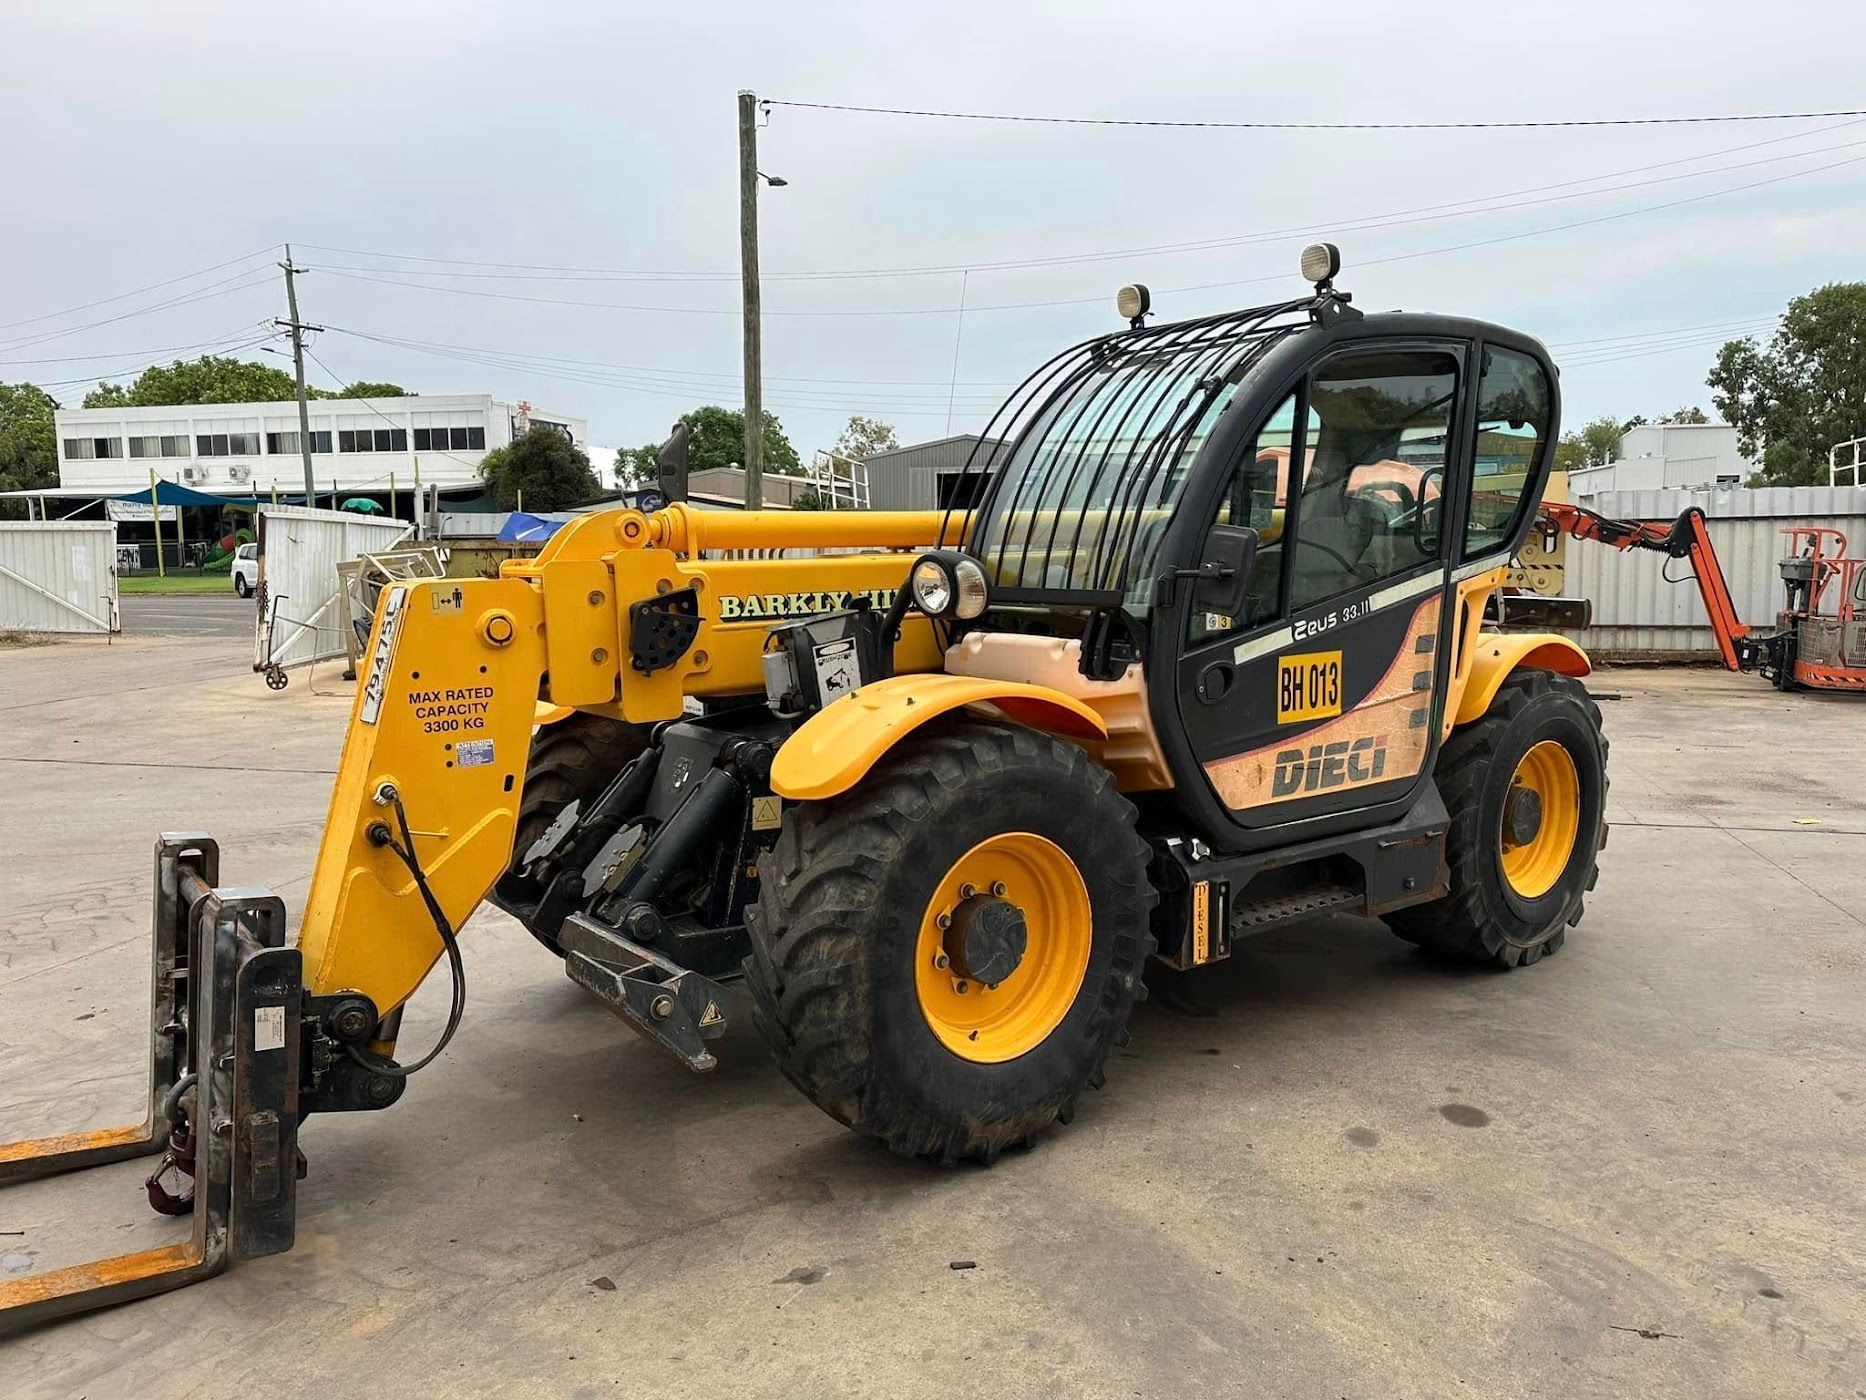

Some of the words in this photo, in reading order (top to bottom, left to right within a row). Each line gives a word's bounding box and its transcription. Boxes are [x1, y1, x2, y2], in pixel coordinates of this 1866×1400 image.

[718, 592, 850, 620] BARKLY
[365, 600, 399, 706] 79A75C
[409, 691, 441, 705] MAX
[446, 687, 494, 702] RATED
[1281, 663, 1304, 712] BH
[1310, 660, 1339, 708] 013
[416, 702, 489, 719] CAPACITY
[424, 719, 459, 734] 3300
[463, 717, 484, 730] KG
[1197, 884, 1206, 960] DIESEL
